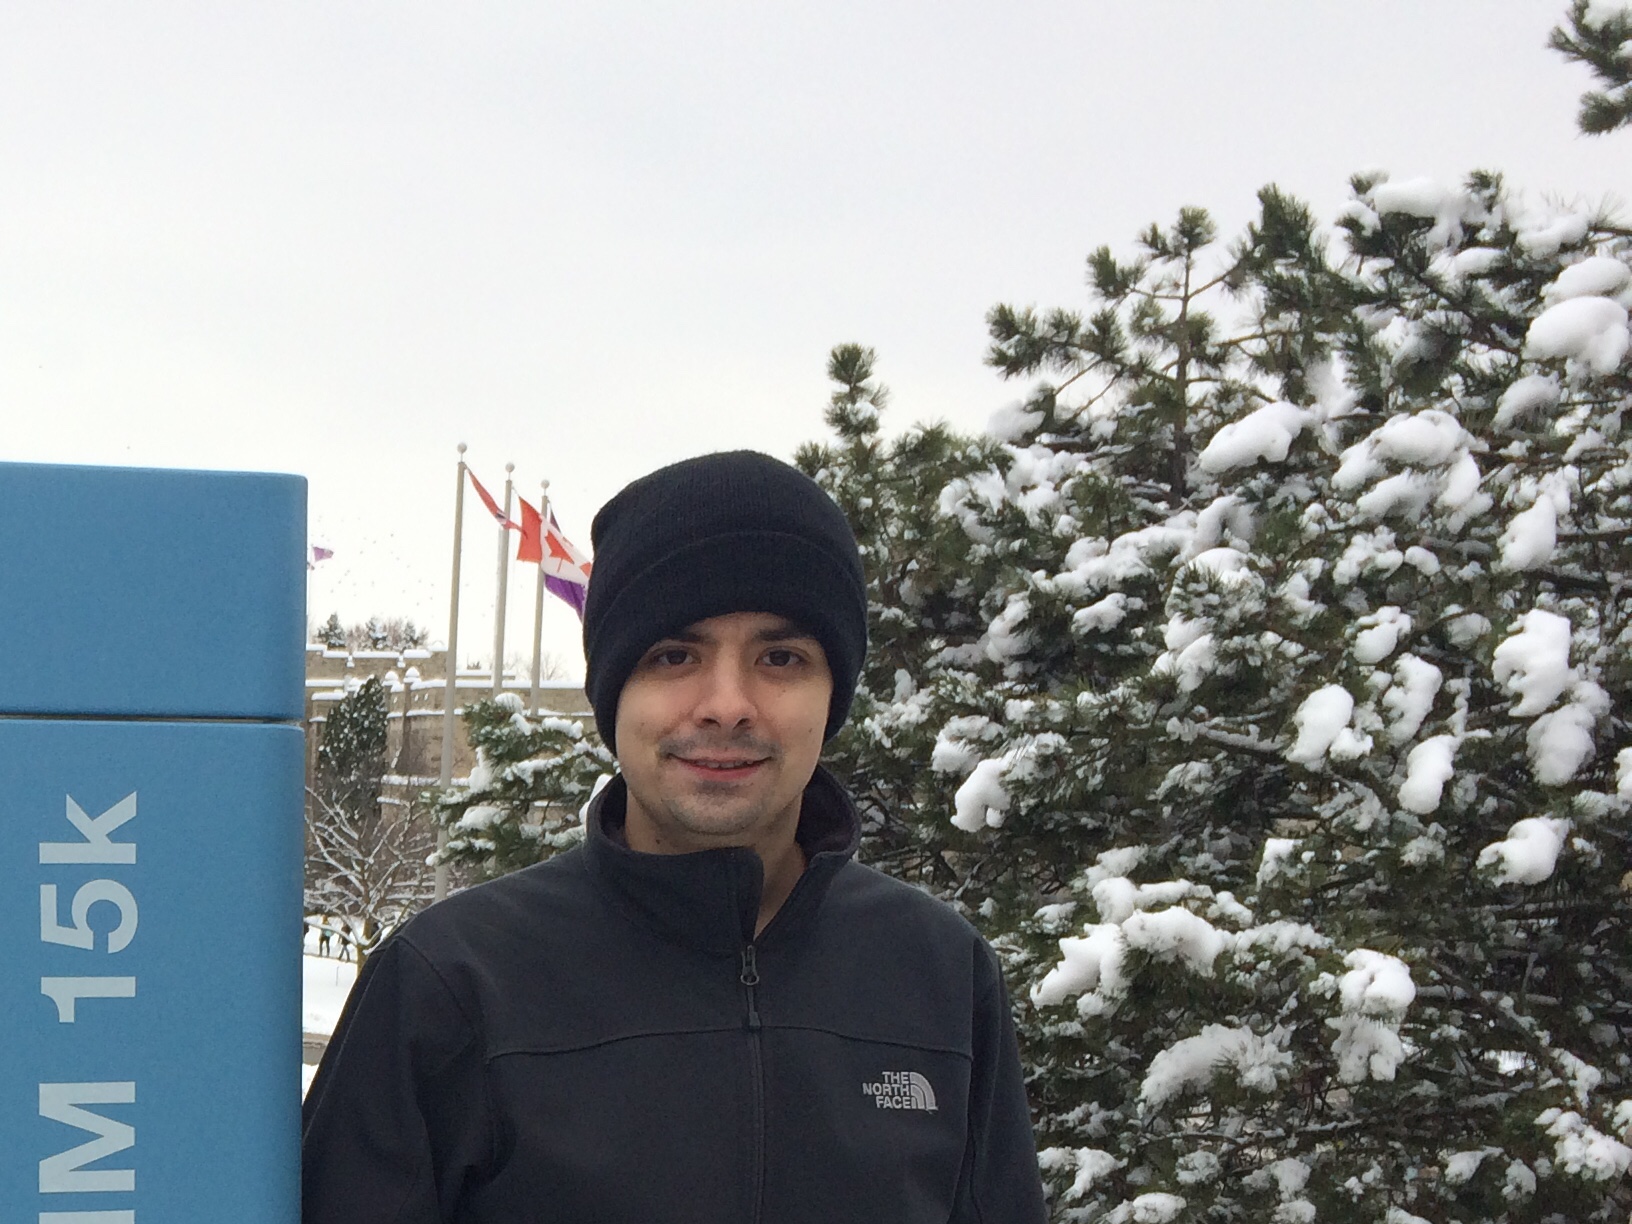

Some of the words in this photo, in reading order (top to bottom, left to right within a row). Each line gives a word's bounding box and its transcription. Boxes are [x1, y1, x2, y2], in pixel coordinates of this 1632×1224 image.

[39, 790, 139, 1024] 15k
[881, 1071, 910, 1085] THE
[862, 1082, 910, 1097] NORTH
[875, 1095, 911, 1110] FACE
